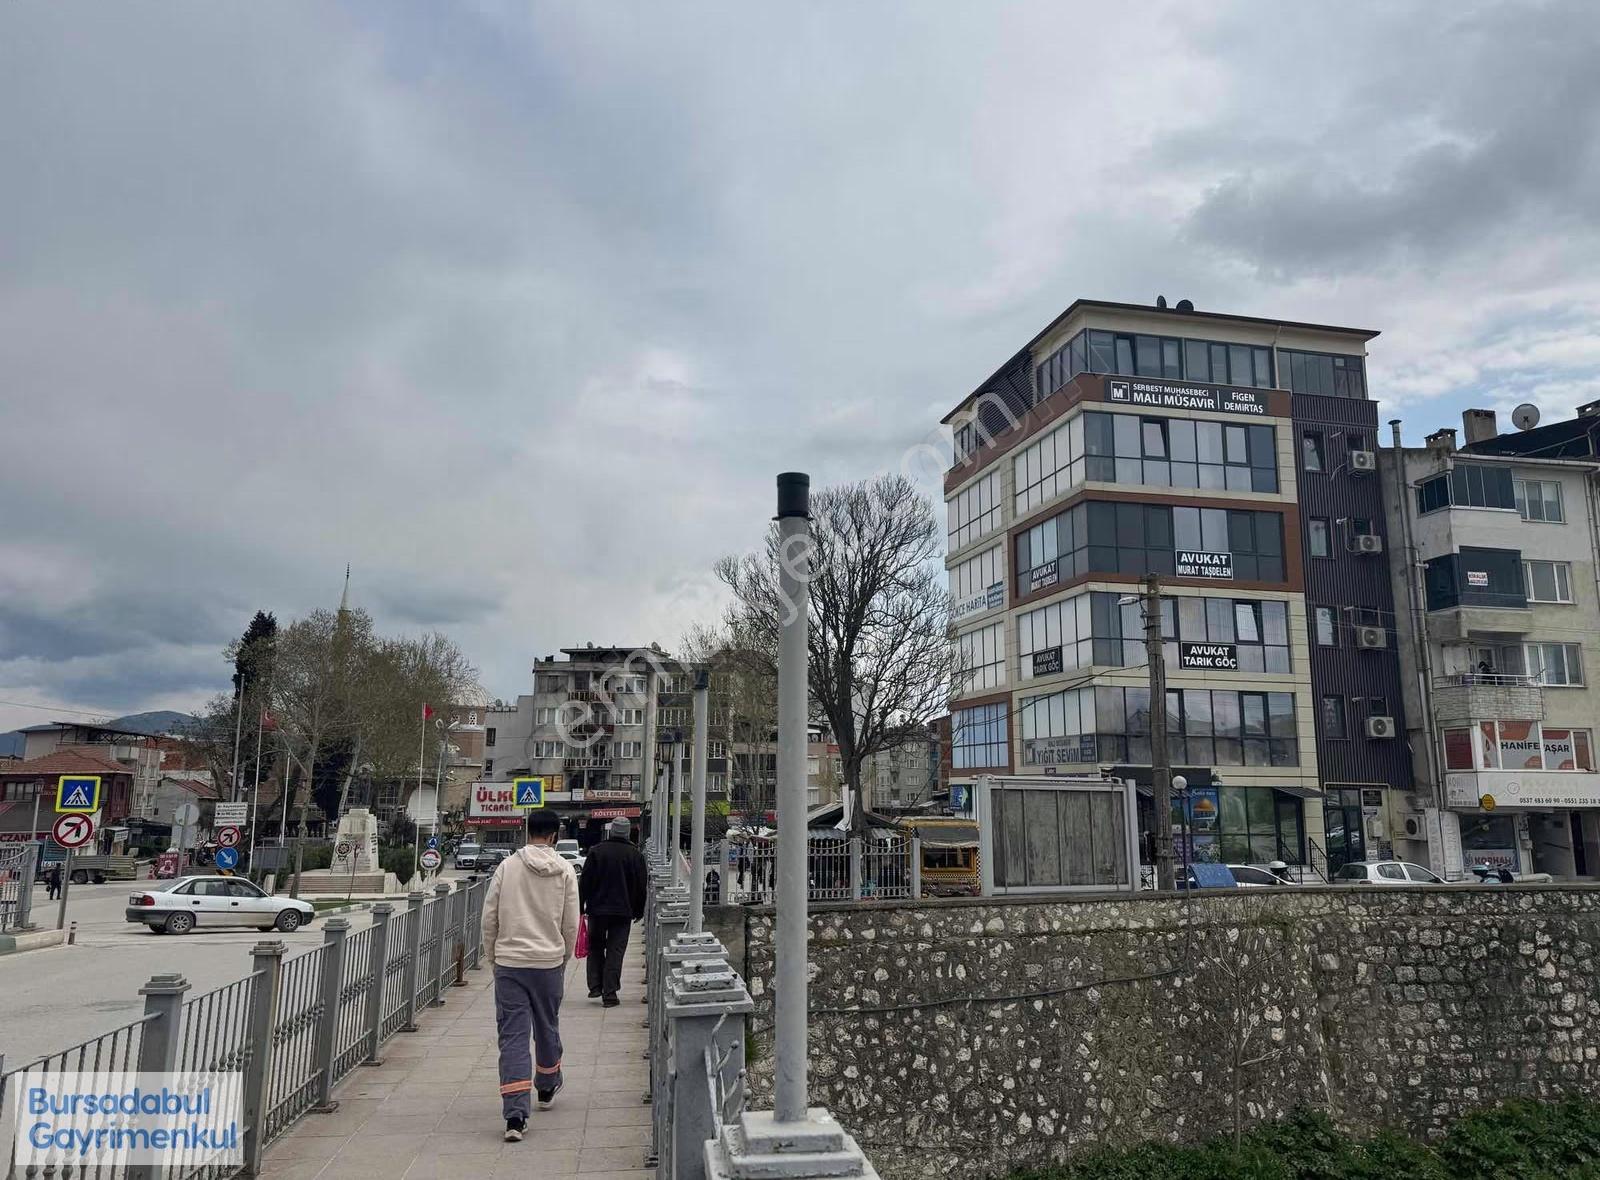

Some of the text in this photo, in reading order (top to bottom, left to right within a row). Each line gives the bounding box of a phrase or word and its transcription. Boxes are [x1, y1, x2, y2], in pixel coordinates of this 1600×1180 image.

[1132, 383, 1163, 393] SERBEST
[1180, 553, 1228, 565] AVUKAT
[1031, 561, 1056, 580] AVUKAT
[1177, 564, 1200, 576] MURAT
[1190, 645, 1229, 656] AVUKAT
[1036, 651, 1055, 664] AVUKAT
[1183, 656, 1237, 669] TARIK GÖÇ
[1500, 740, 1570, 756] HANİFE AŞAR
